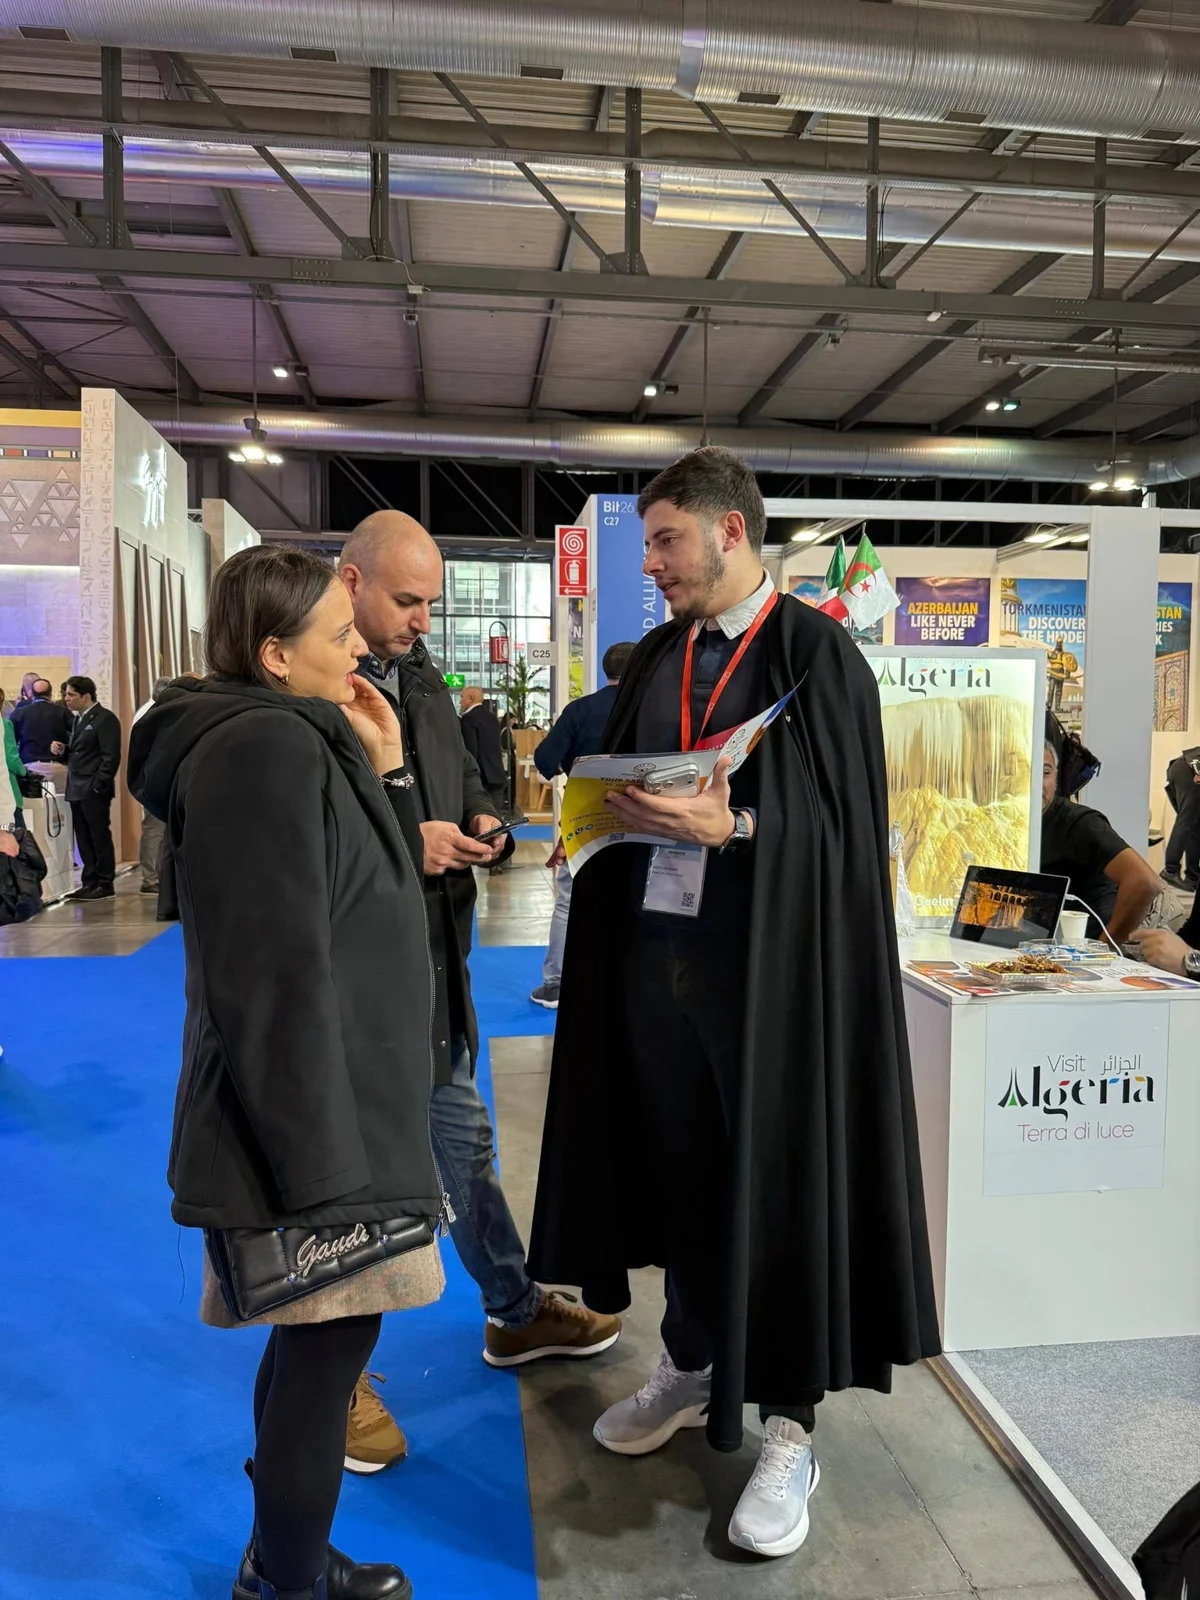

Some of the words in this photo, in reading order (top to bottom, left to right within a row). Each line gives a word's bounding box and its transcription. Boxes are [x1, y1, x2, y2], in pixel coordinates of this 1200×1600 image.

[603, 517, 620, 526] C27
[907, 602, 979, 615] AZERBAIJAN
[911, 615, 937, 627] LIKE
[939, 615, 976, 628] NEVER
[1028, 616, 1086, 630] DISCOVER
[921, 628, 965, 641] BEFORE
[1021, 630, 1044, 643] THE
[532, 650, 551, 658] C25
[877, 657, 991, 698] Algeria
[1046, 1054, 1086, 1073] Visit
[1100, 1054, 1141, 1076] الجزائر
[997, 1065, 1154, 1122] Algeria
[1017, 1124, 1068, 1142] Terra
[1074, 1122, 1090, 1140] di
[1096, 1121, 1135, 1139] luce
